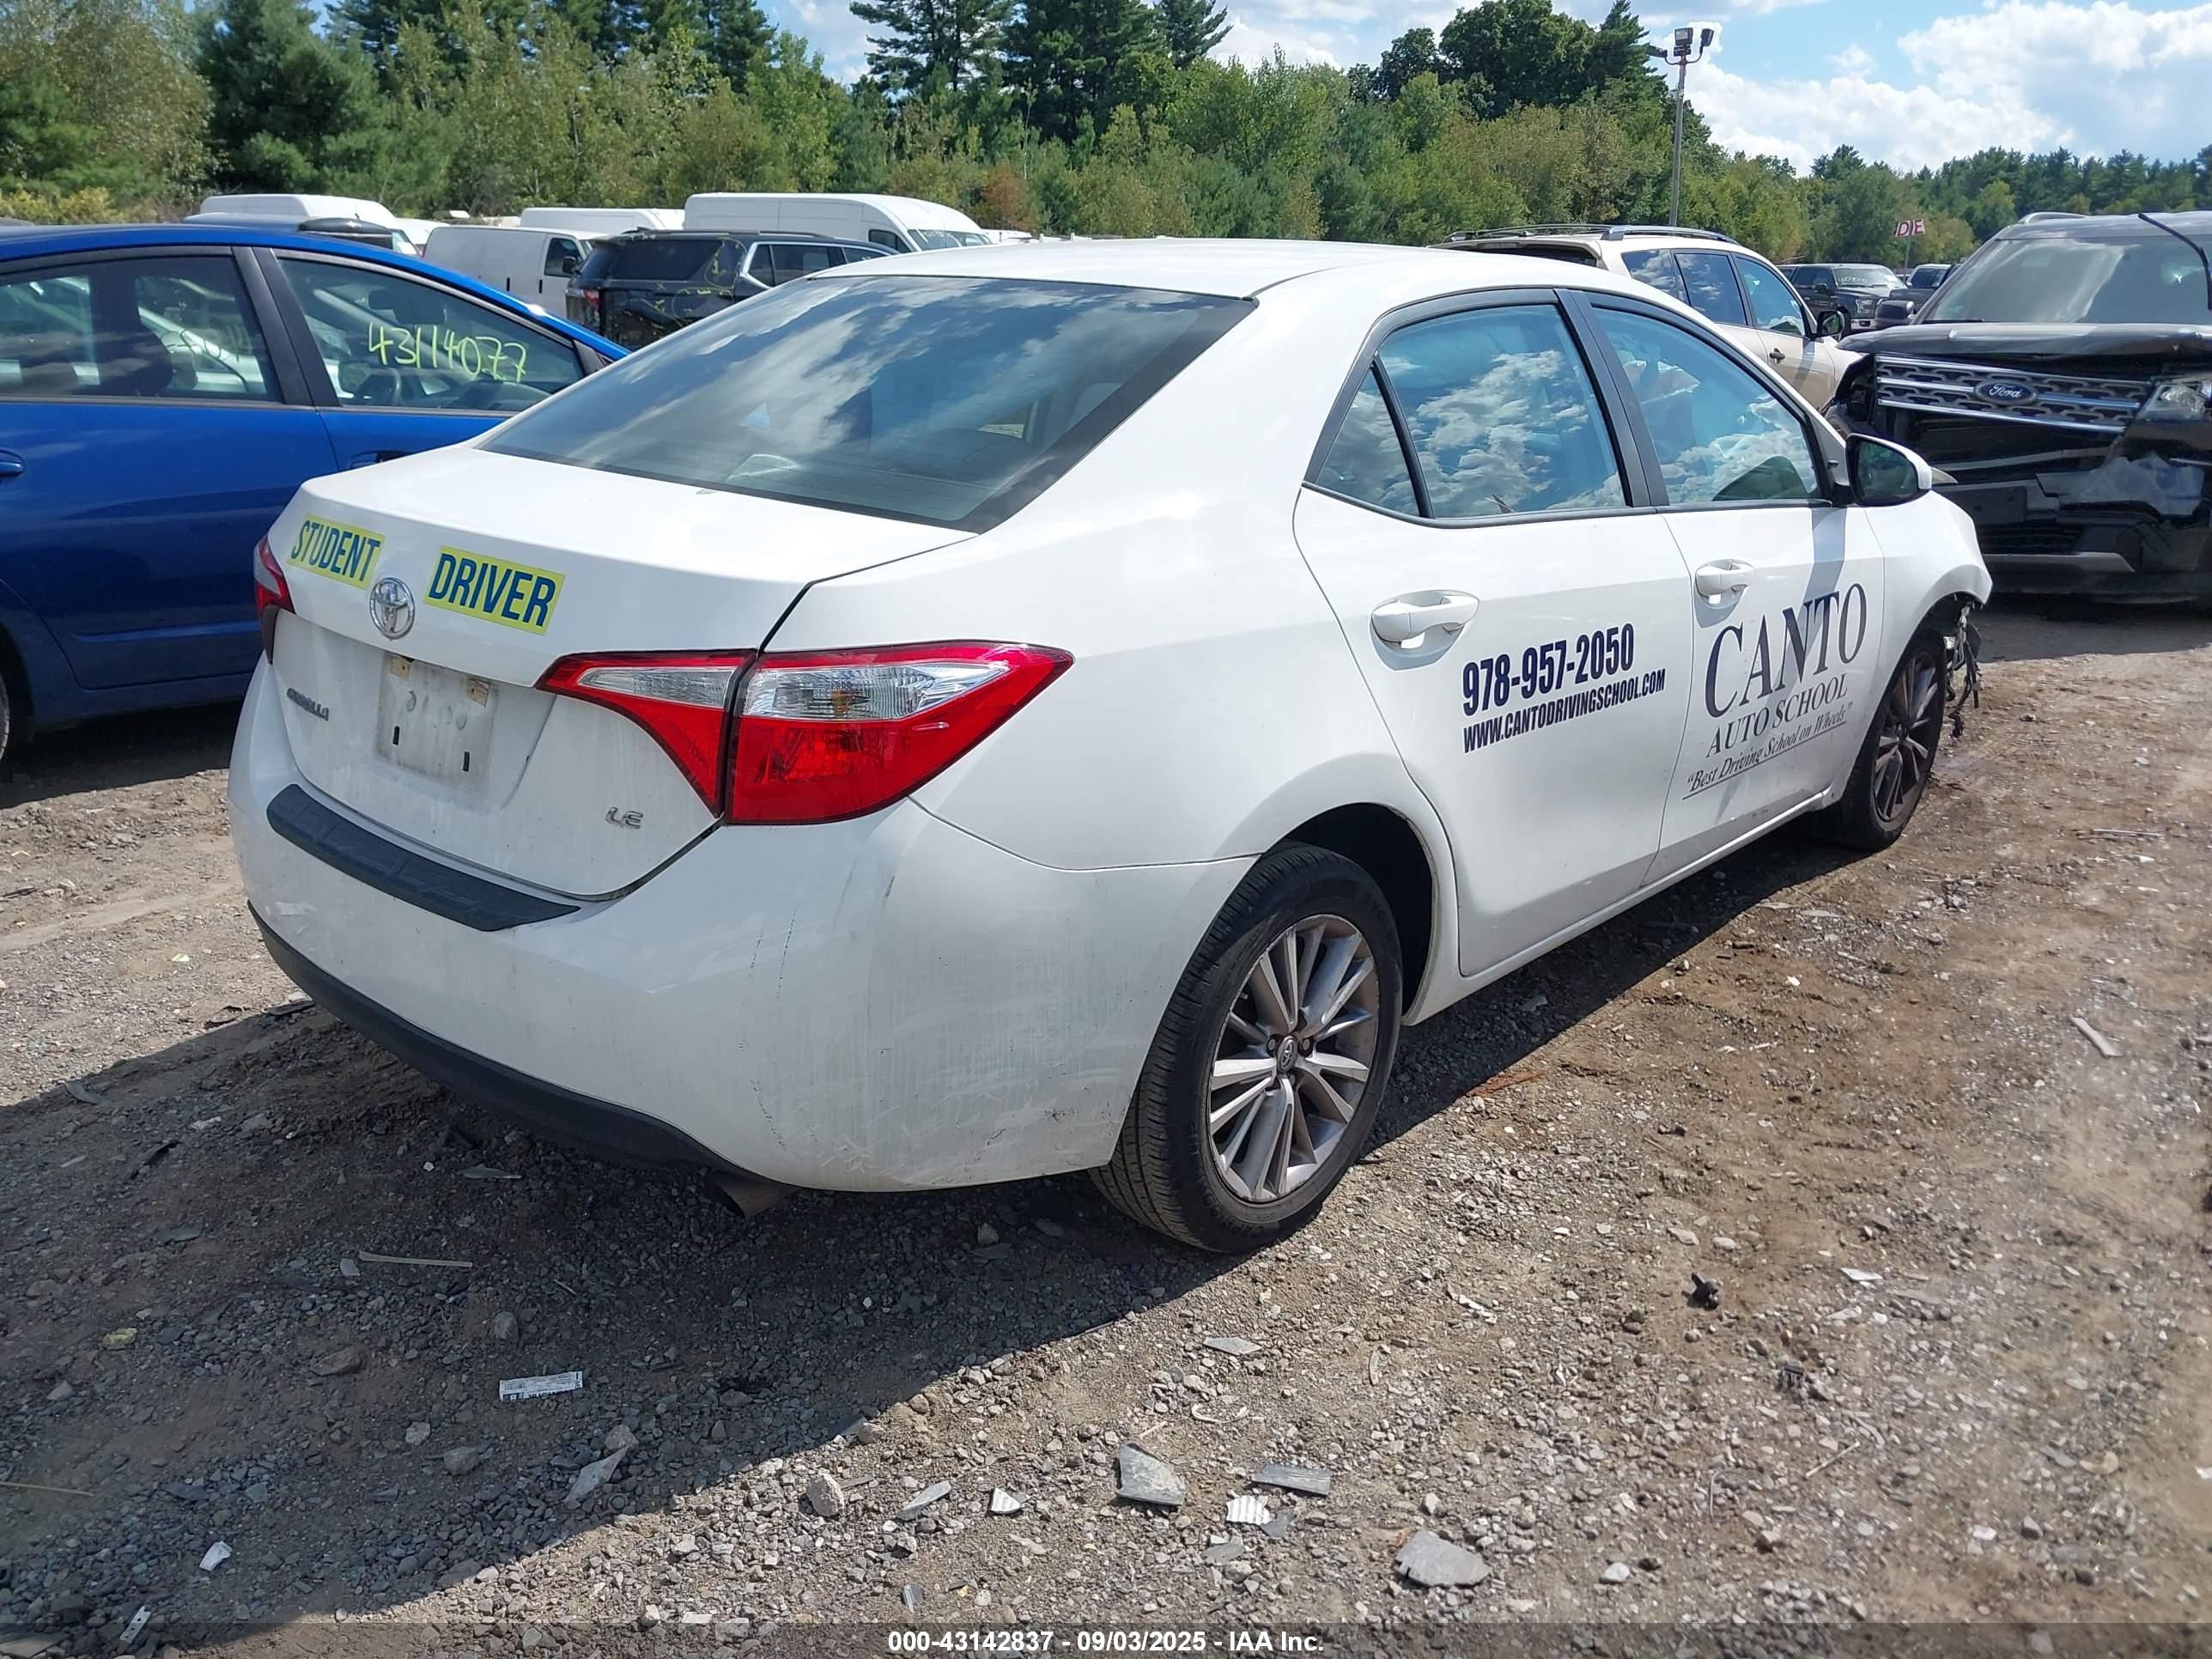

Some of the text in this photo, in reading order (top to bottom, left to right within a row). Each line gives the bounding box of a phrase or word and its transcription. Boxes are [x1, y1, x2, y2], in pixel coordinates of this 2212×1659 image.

[369, 322, 526, 383] 43114077
[1989, 383, 2021, 398] Ford
[290, 520, 556, 628] STUDENT DRIVER
[1462, 623, 1634, 716] 978-957-2050
[1705, 582, 1868, 718] CANTO
[1463, 668, 1666, 754] WWW.CANTODRIVINGSCHOOL.COM
[1705, 673, 1848, 758] AUTO SCHOOL
[1718, 747, 1763, 779] Driving
[1764, 724, 1802, 757] School
[1799, 725, 1813, 741] on
[605, 806, 644, 830] LE
